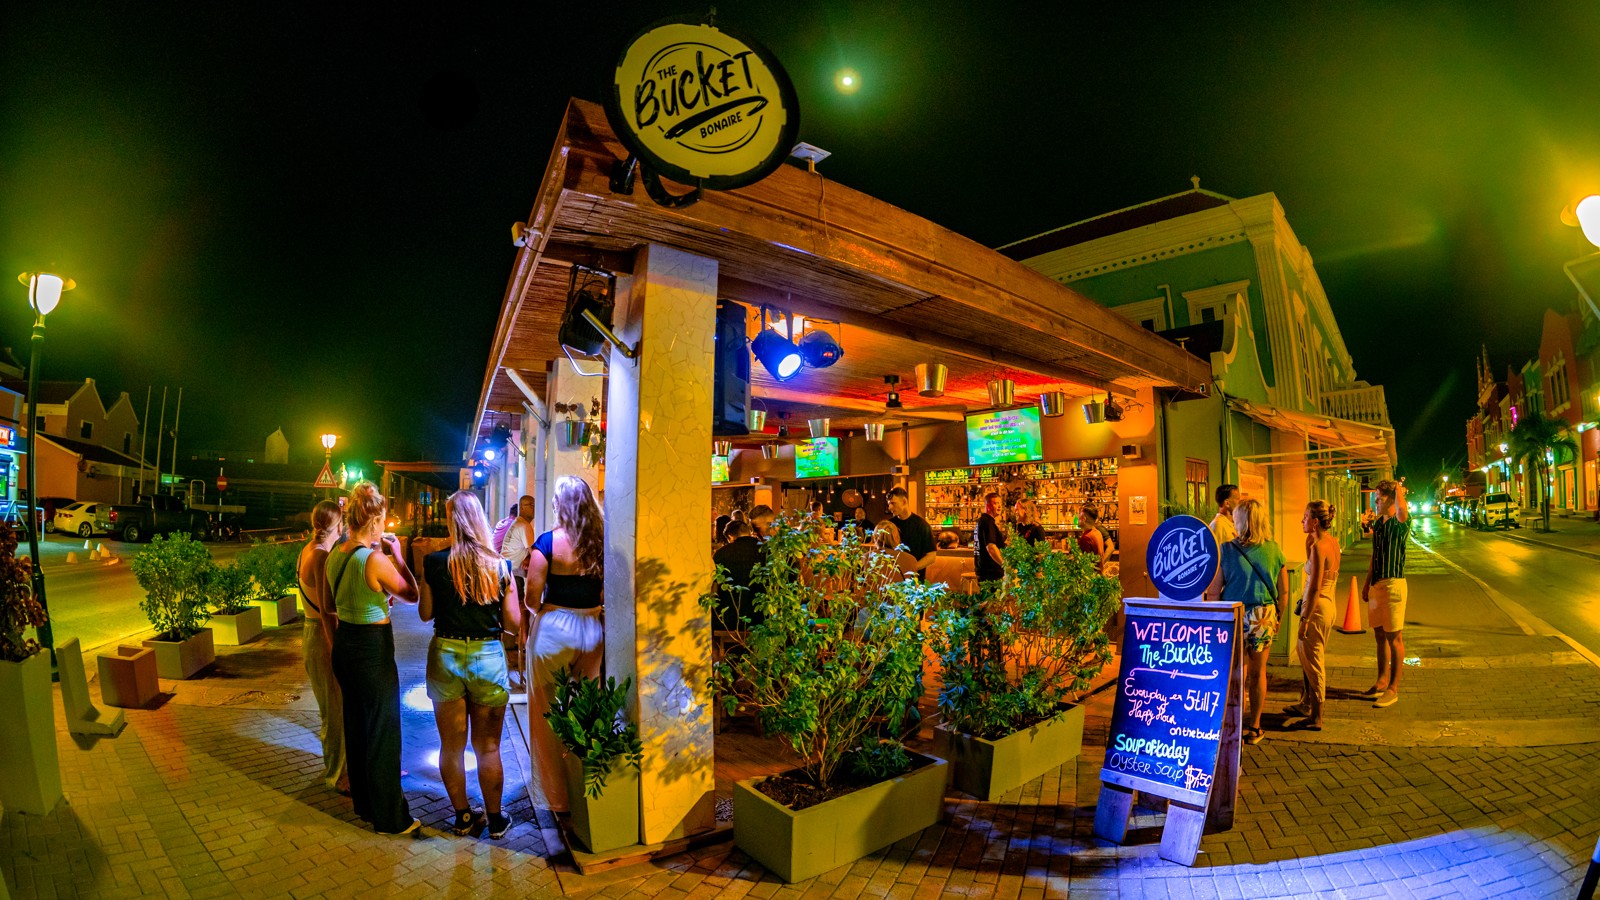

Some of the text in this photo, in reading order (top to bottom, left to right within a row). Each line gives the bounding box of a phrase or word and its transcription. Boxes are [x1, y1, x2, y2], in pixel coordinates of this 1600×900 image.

[657, 65, 677, 80] THE
[635, 51, 753, 129] BUCKET
[700, 111, 742, 138] BONAIRE
[1153, 527, 1207, 578] BUCKET
[1162, 543, 1171, 552] THE
[1177, 564, 1198, 582] BONAIRE
[1132, 621, 1229, 644] WELCOME to
[1139, 641, 1213, 668] The Bucket
[1128, 699, 1156, 726] Happy
[1169, 726, 1181, 736] on
[1182, 727, 1196, 738] the
